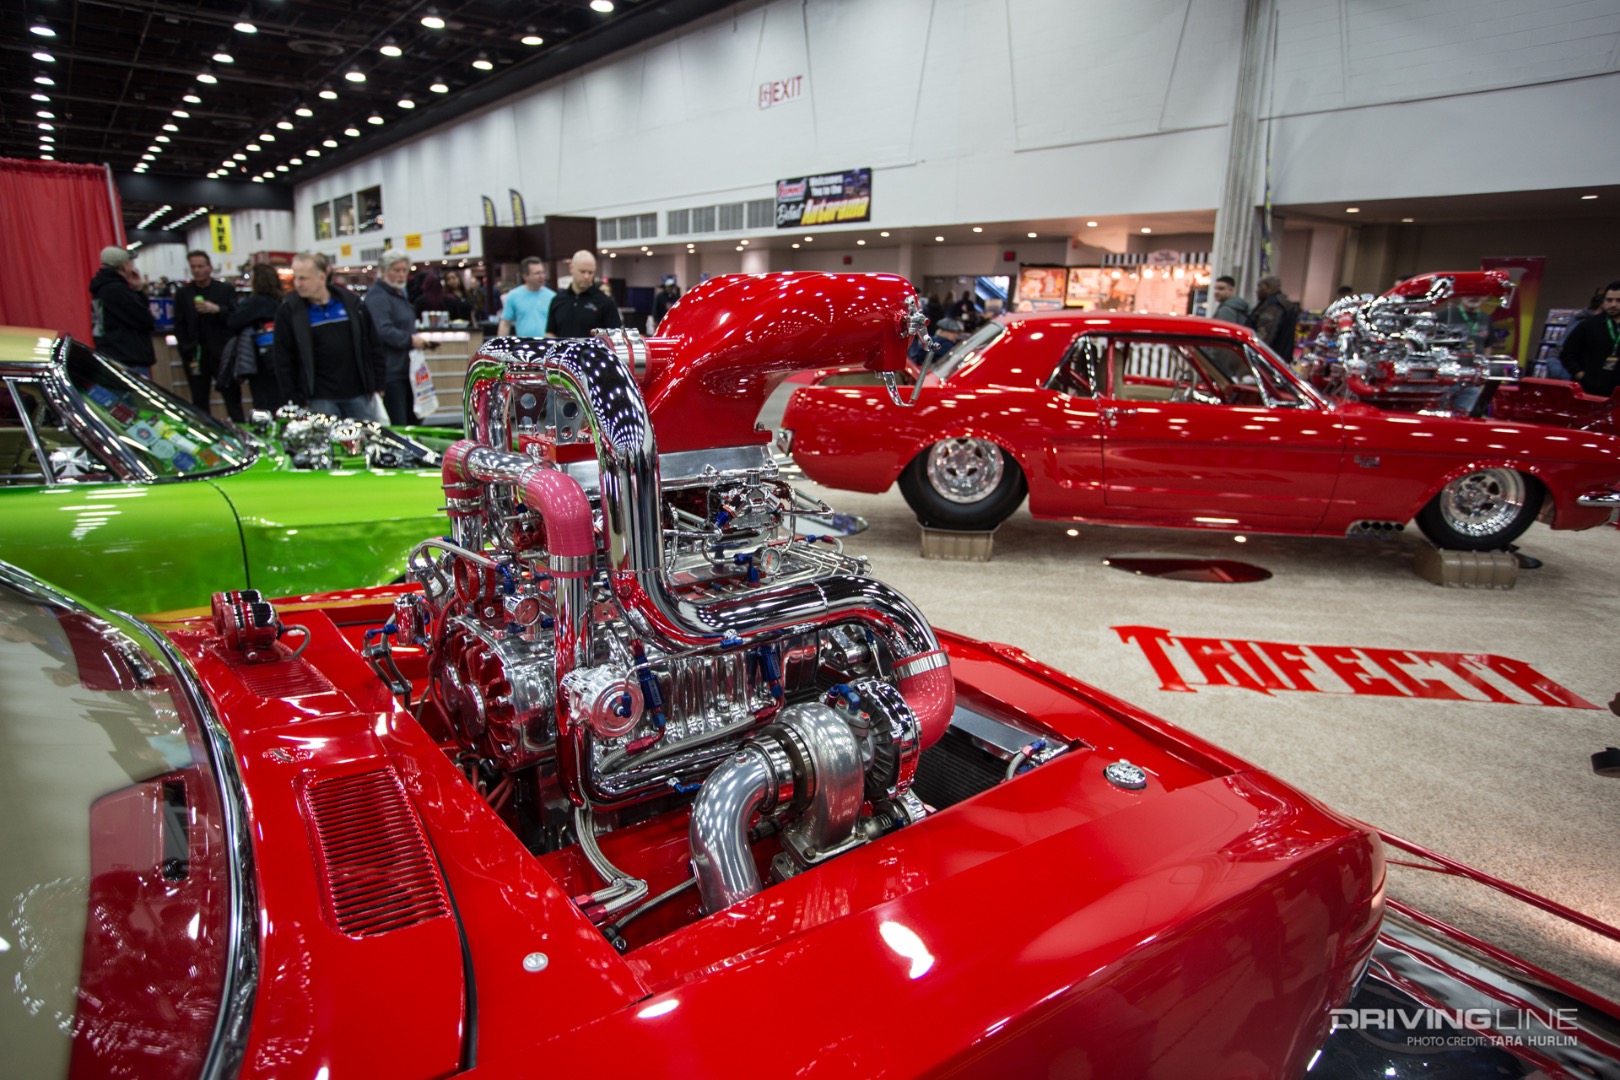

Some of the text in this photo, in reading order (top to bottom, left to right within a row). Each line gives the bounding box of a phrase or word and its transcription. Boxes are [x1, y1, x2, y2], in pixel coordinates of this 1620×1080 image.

[772, 75, 803, 103] EXIT
[801, 196, 869, 225] Autorama
[217, 217, 227, 252] INFO
[1110, 625, 1608, 710] TRIFECTA
